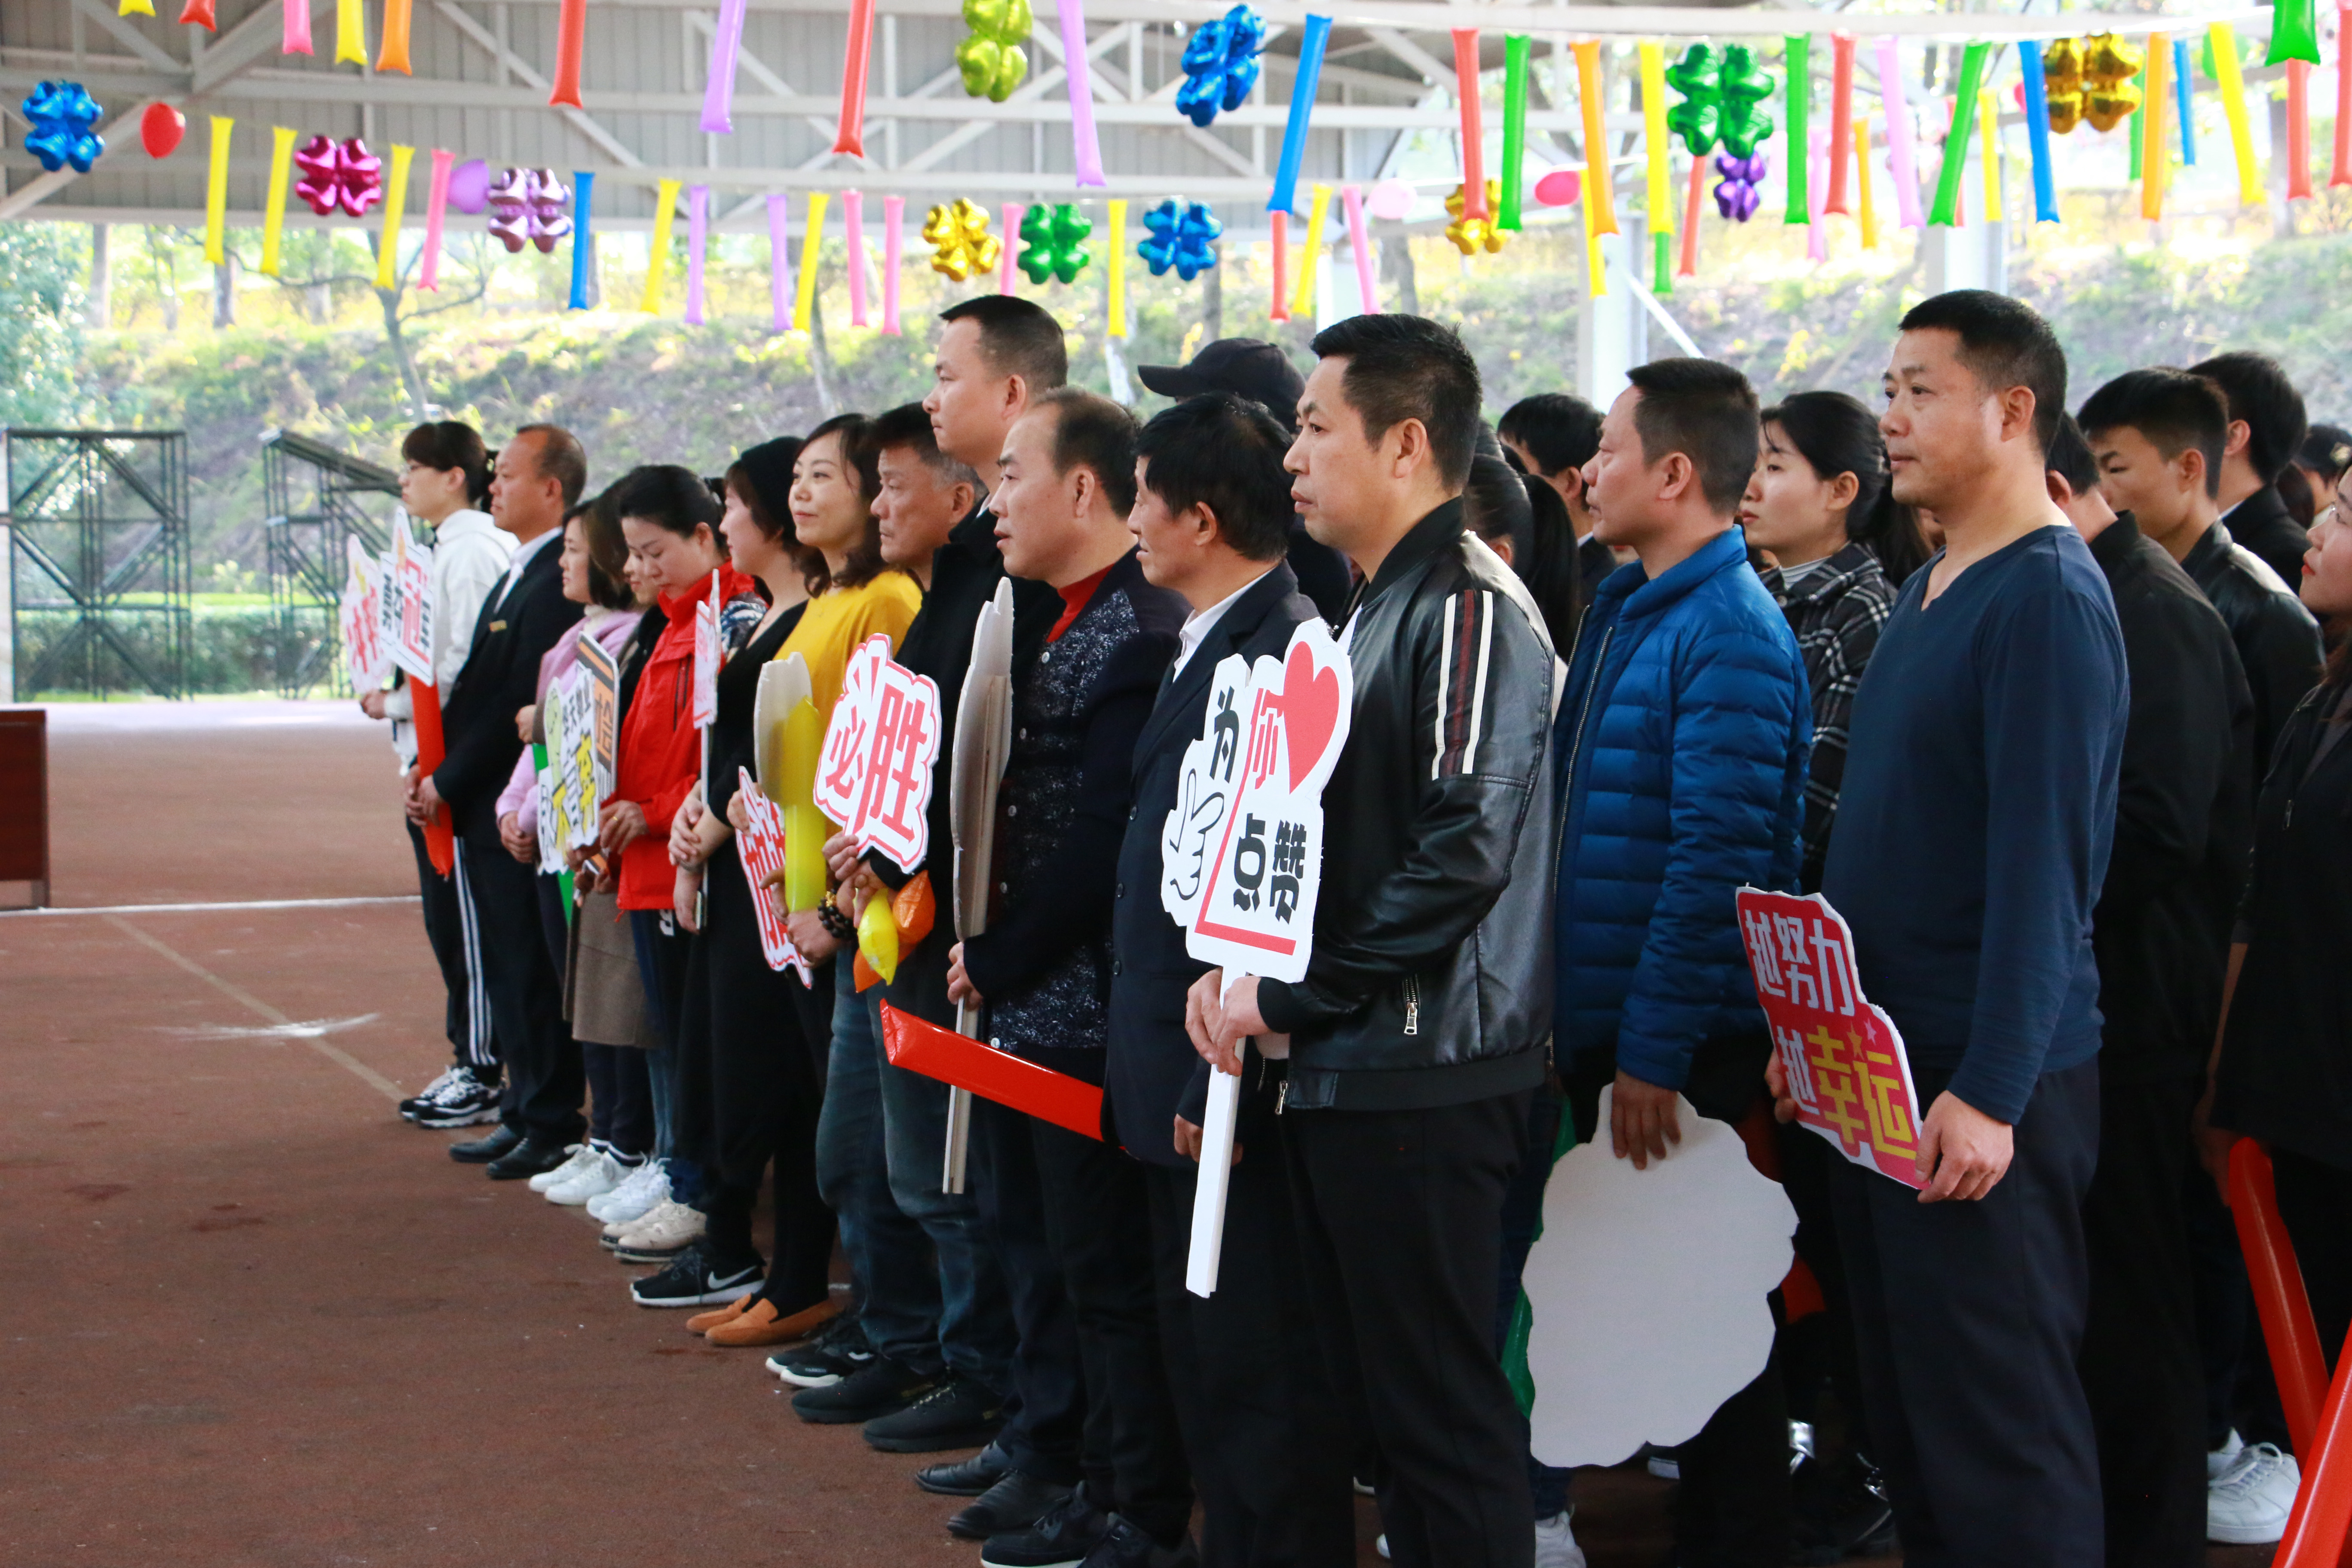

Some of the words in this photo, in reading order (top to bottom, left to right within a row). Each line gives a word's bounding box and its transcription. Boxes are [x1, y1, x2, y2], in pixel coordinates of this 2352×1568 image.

[826, 671, 927, 842] 必胜
[1209, 685, 1284, 790] 为你
[1233, 812, 1307, 925] 点赞
[1745, 909, 1854, 1016] 越努力
[1777, 1025, 1917, 1160] 越幸运
